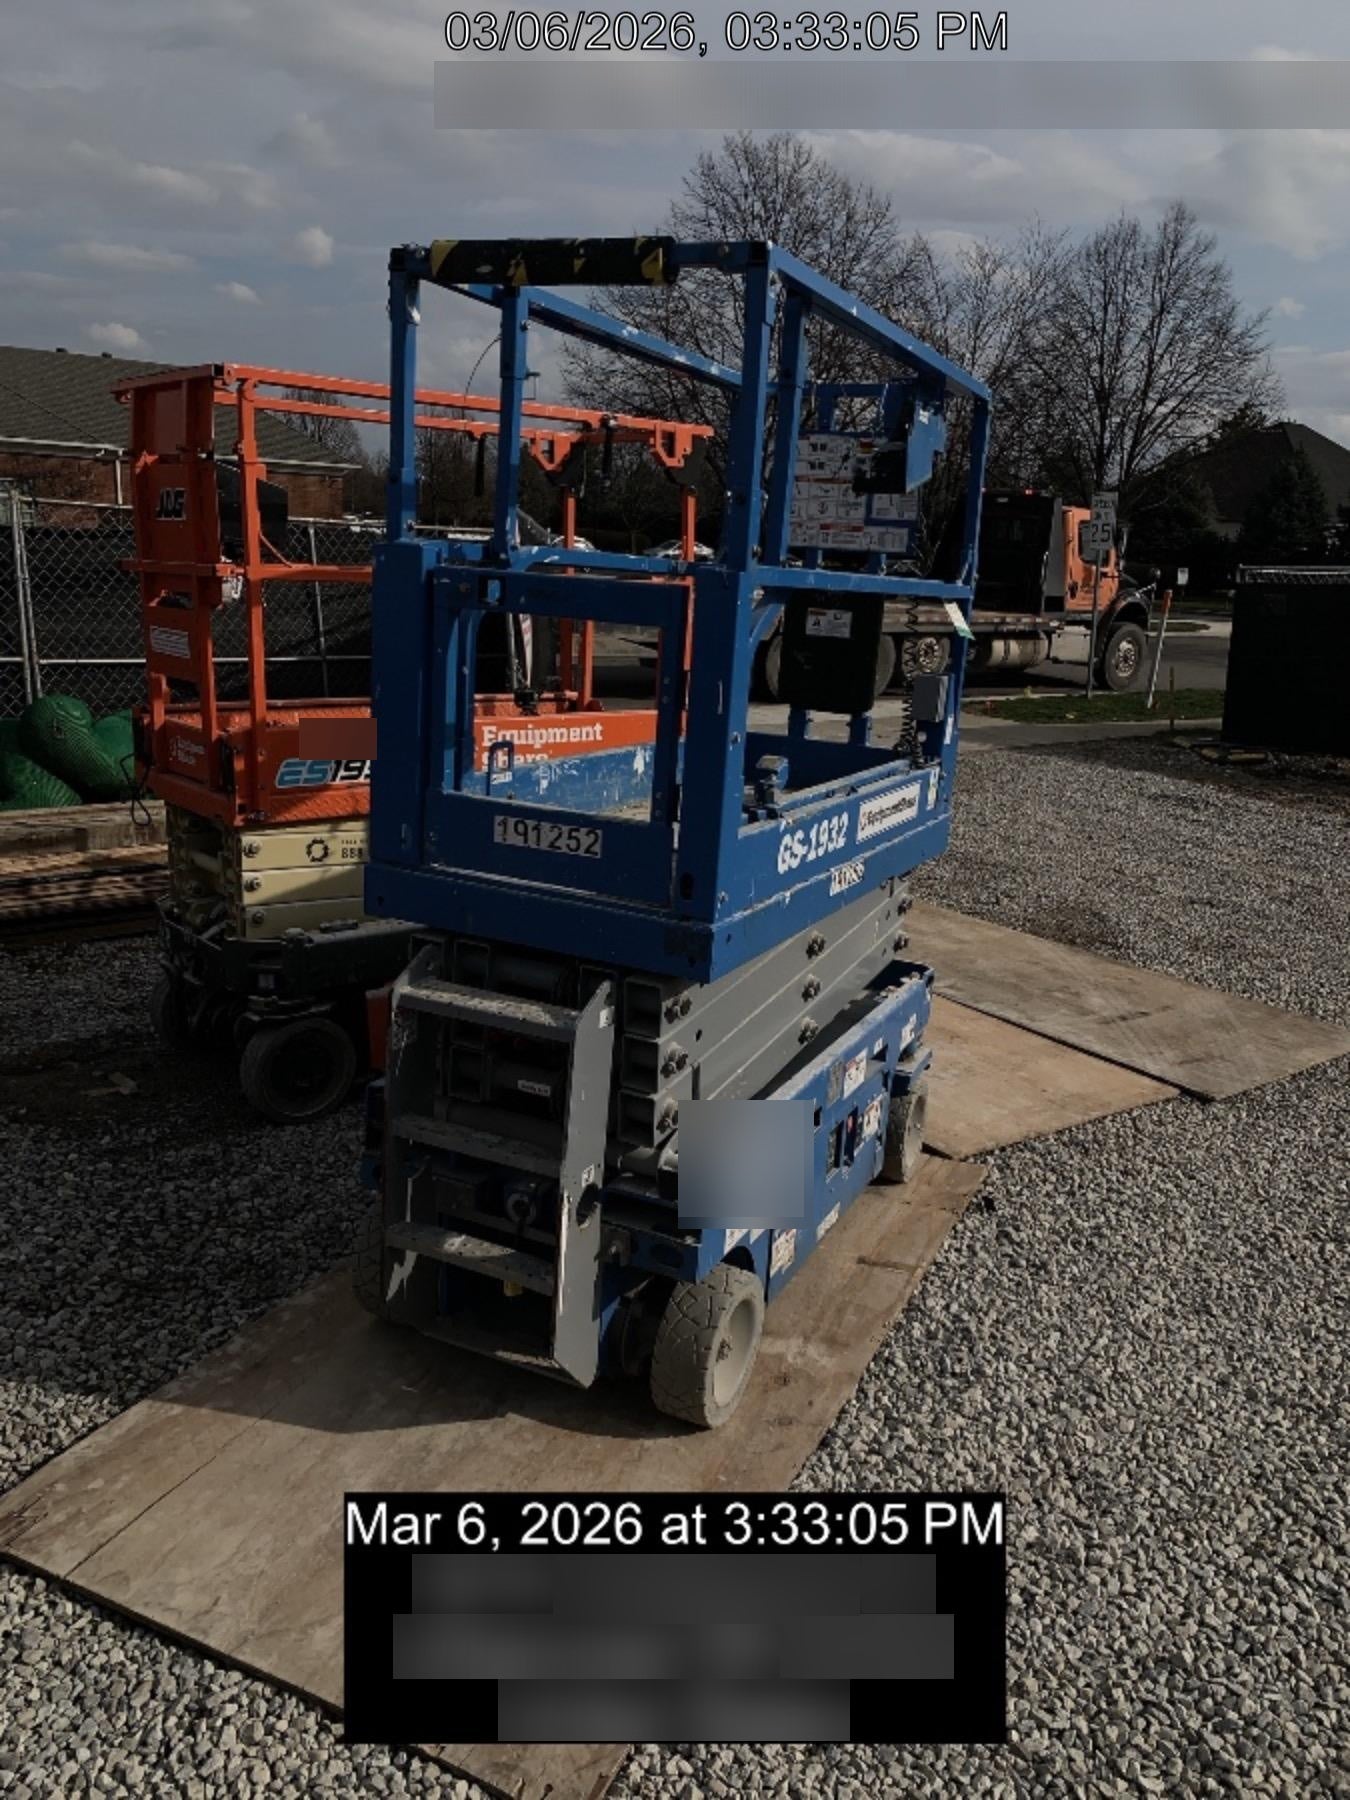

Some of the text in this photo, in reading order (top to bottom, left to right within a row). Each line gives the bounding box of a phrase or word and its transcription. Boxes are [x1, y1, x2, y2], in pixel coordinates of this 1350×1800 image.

[1091, 523, 1110, 542] 25
[482, 723, 604, 749] Equipment
[276, 758, 371, 788] ES19
[497, 817, 600, 856] 191252
[777, 811, 849, 875] GS-1932
